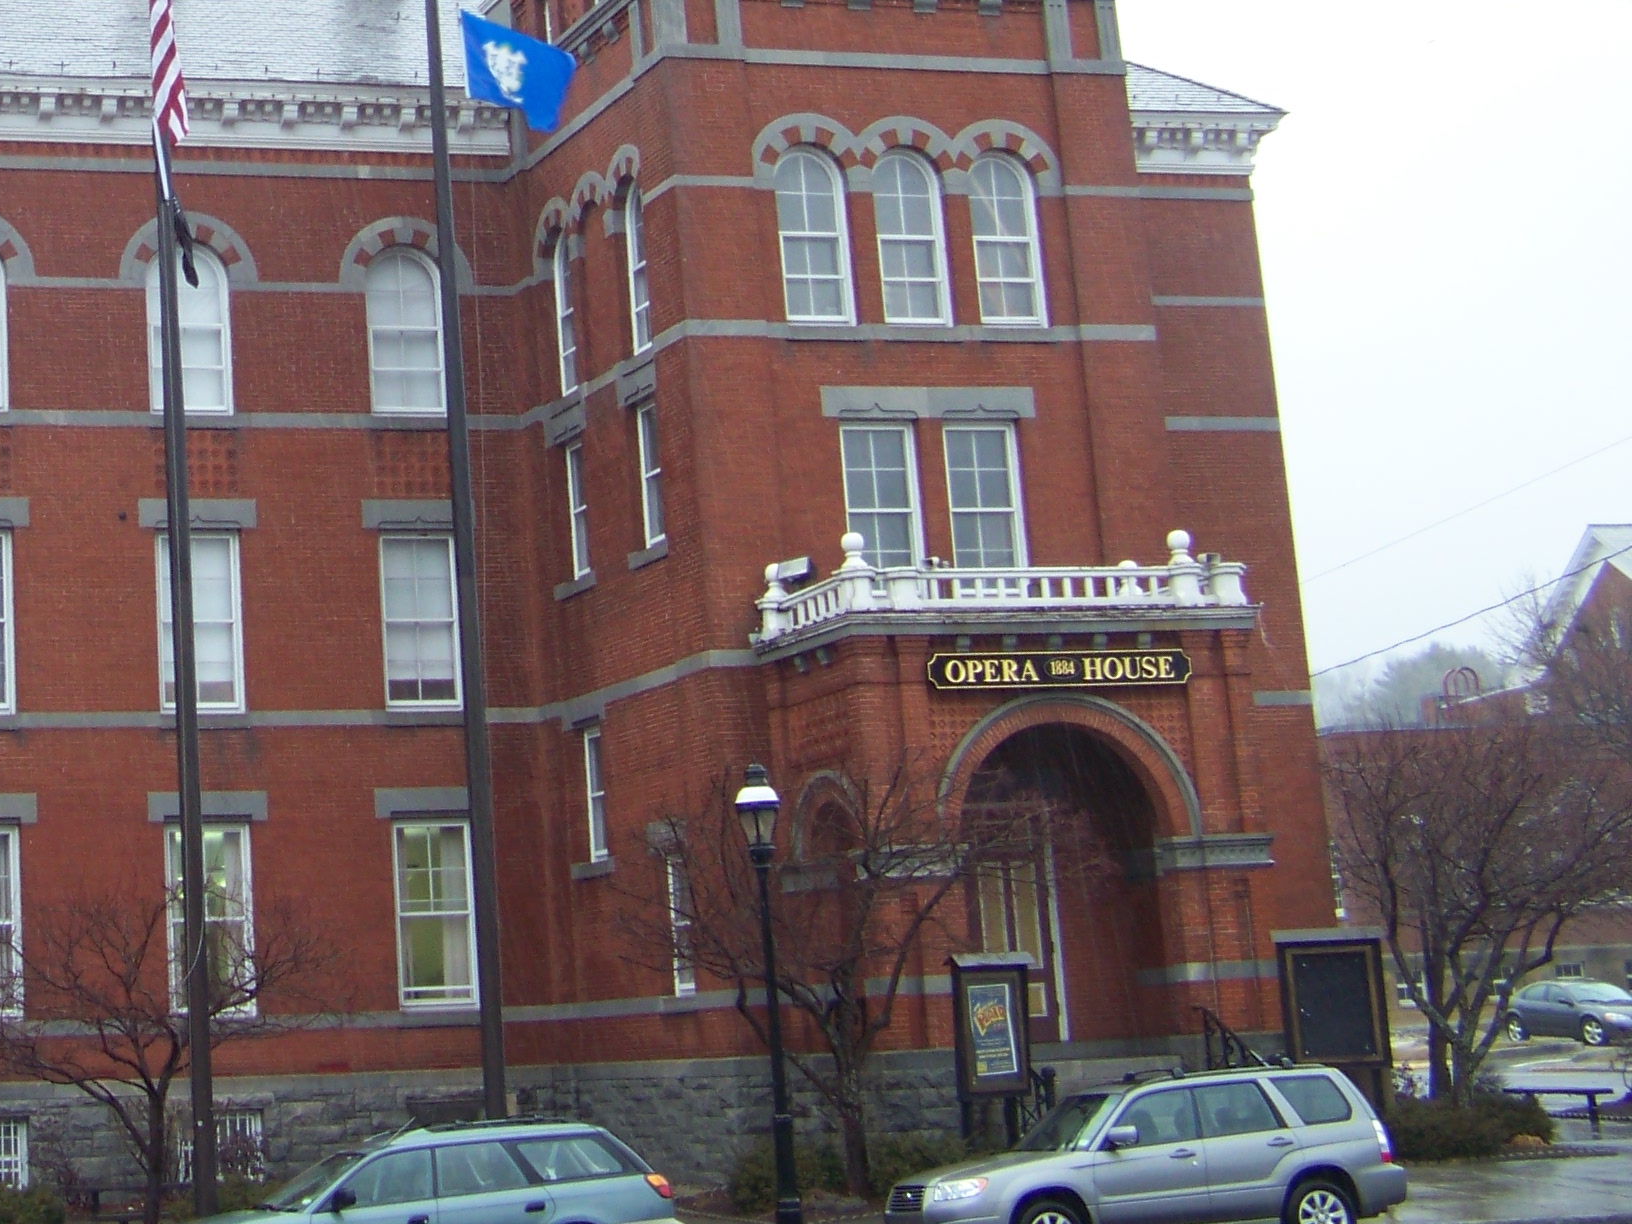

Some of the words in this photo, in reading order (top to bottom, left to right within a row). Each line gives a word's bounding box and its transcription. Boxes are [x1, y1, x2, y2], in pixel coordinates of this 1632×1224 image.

[945, 659, 1040, 683] OPERA
[1049, 659, 1075, 675] 1884
[1082, 656, 1175, 680] HOUSE
